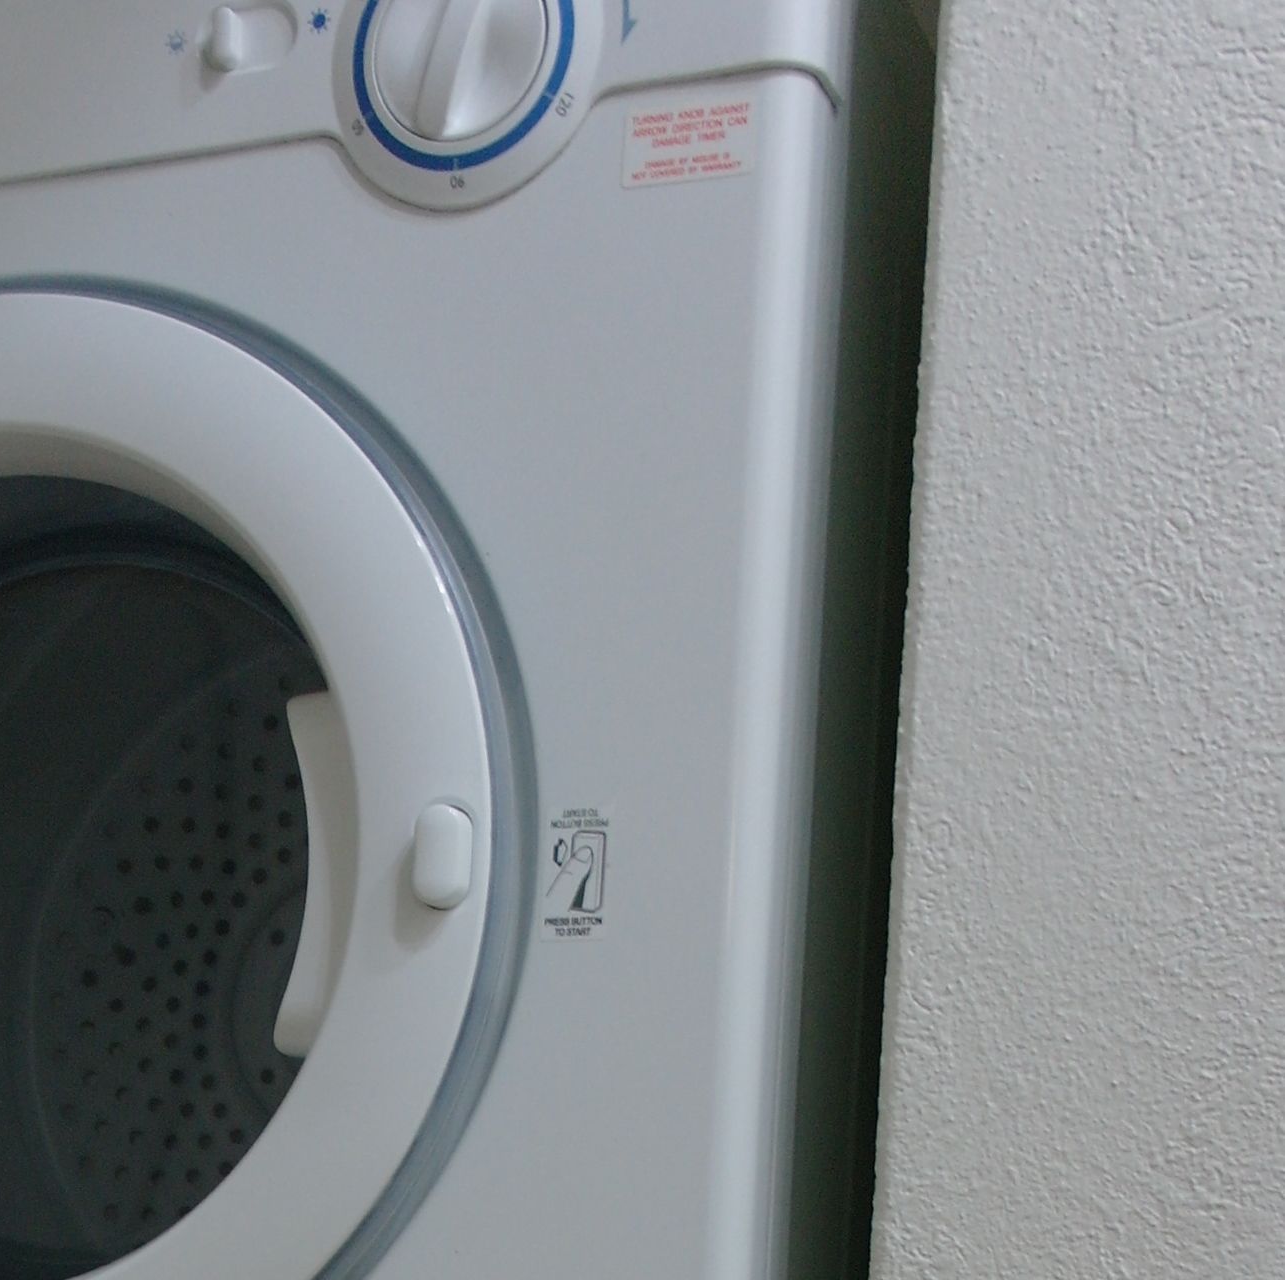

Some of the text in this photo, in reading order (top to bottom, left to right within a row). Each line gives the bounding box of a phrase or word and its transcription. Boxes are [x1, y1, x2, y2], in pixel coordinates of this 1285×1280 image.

[555, 92, 575, 118] 120
[672, 118, 723, 133] DIRECTION
[727, 115, 748, 127] CAN
